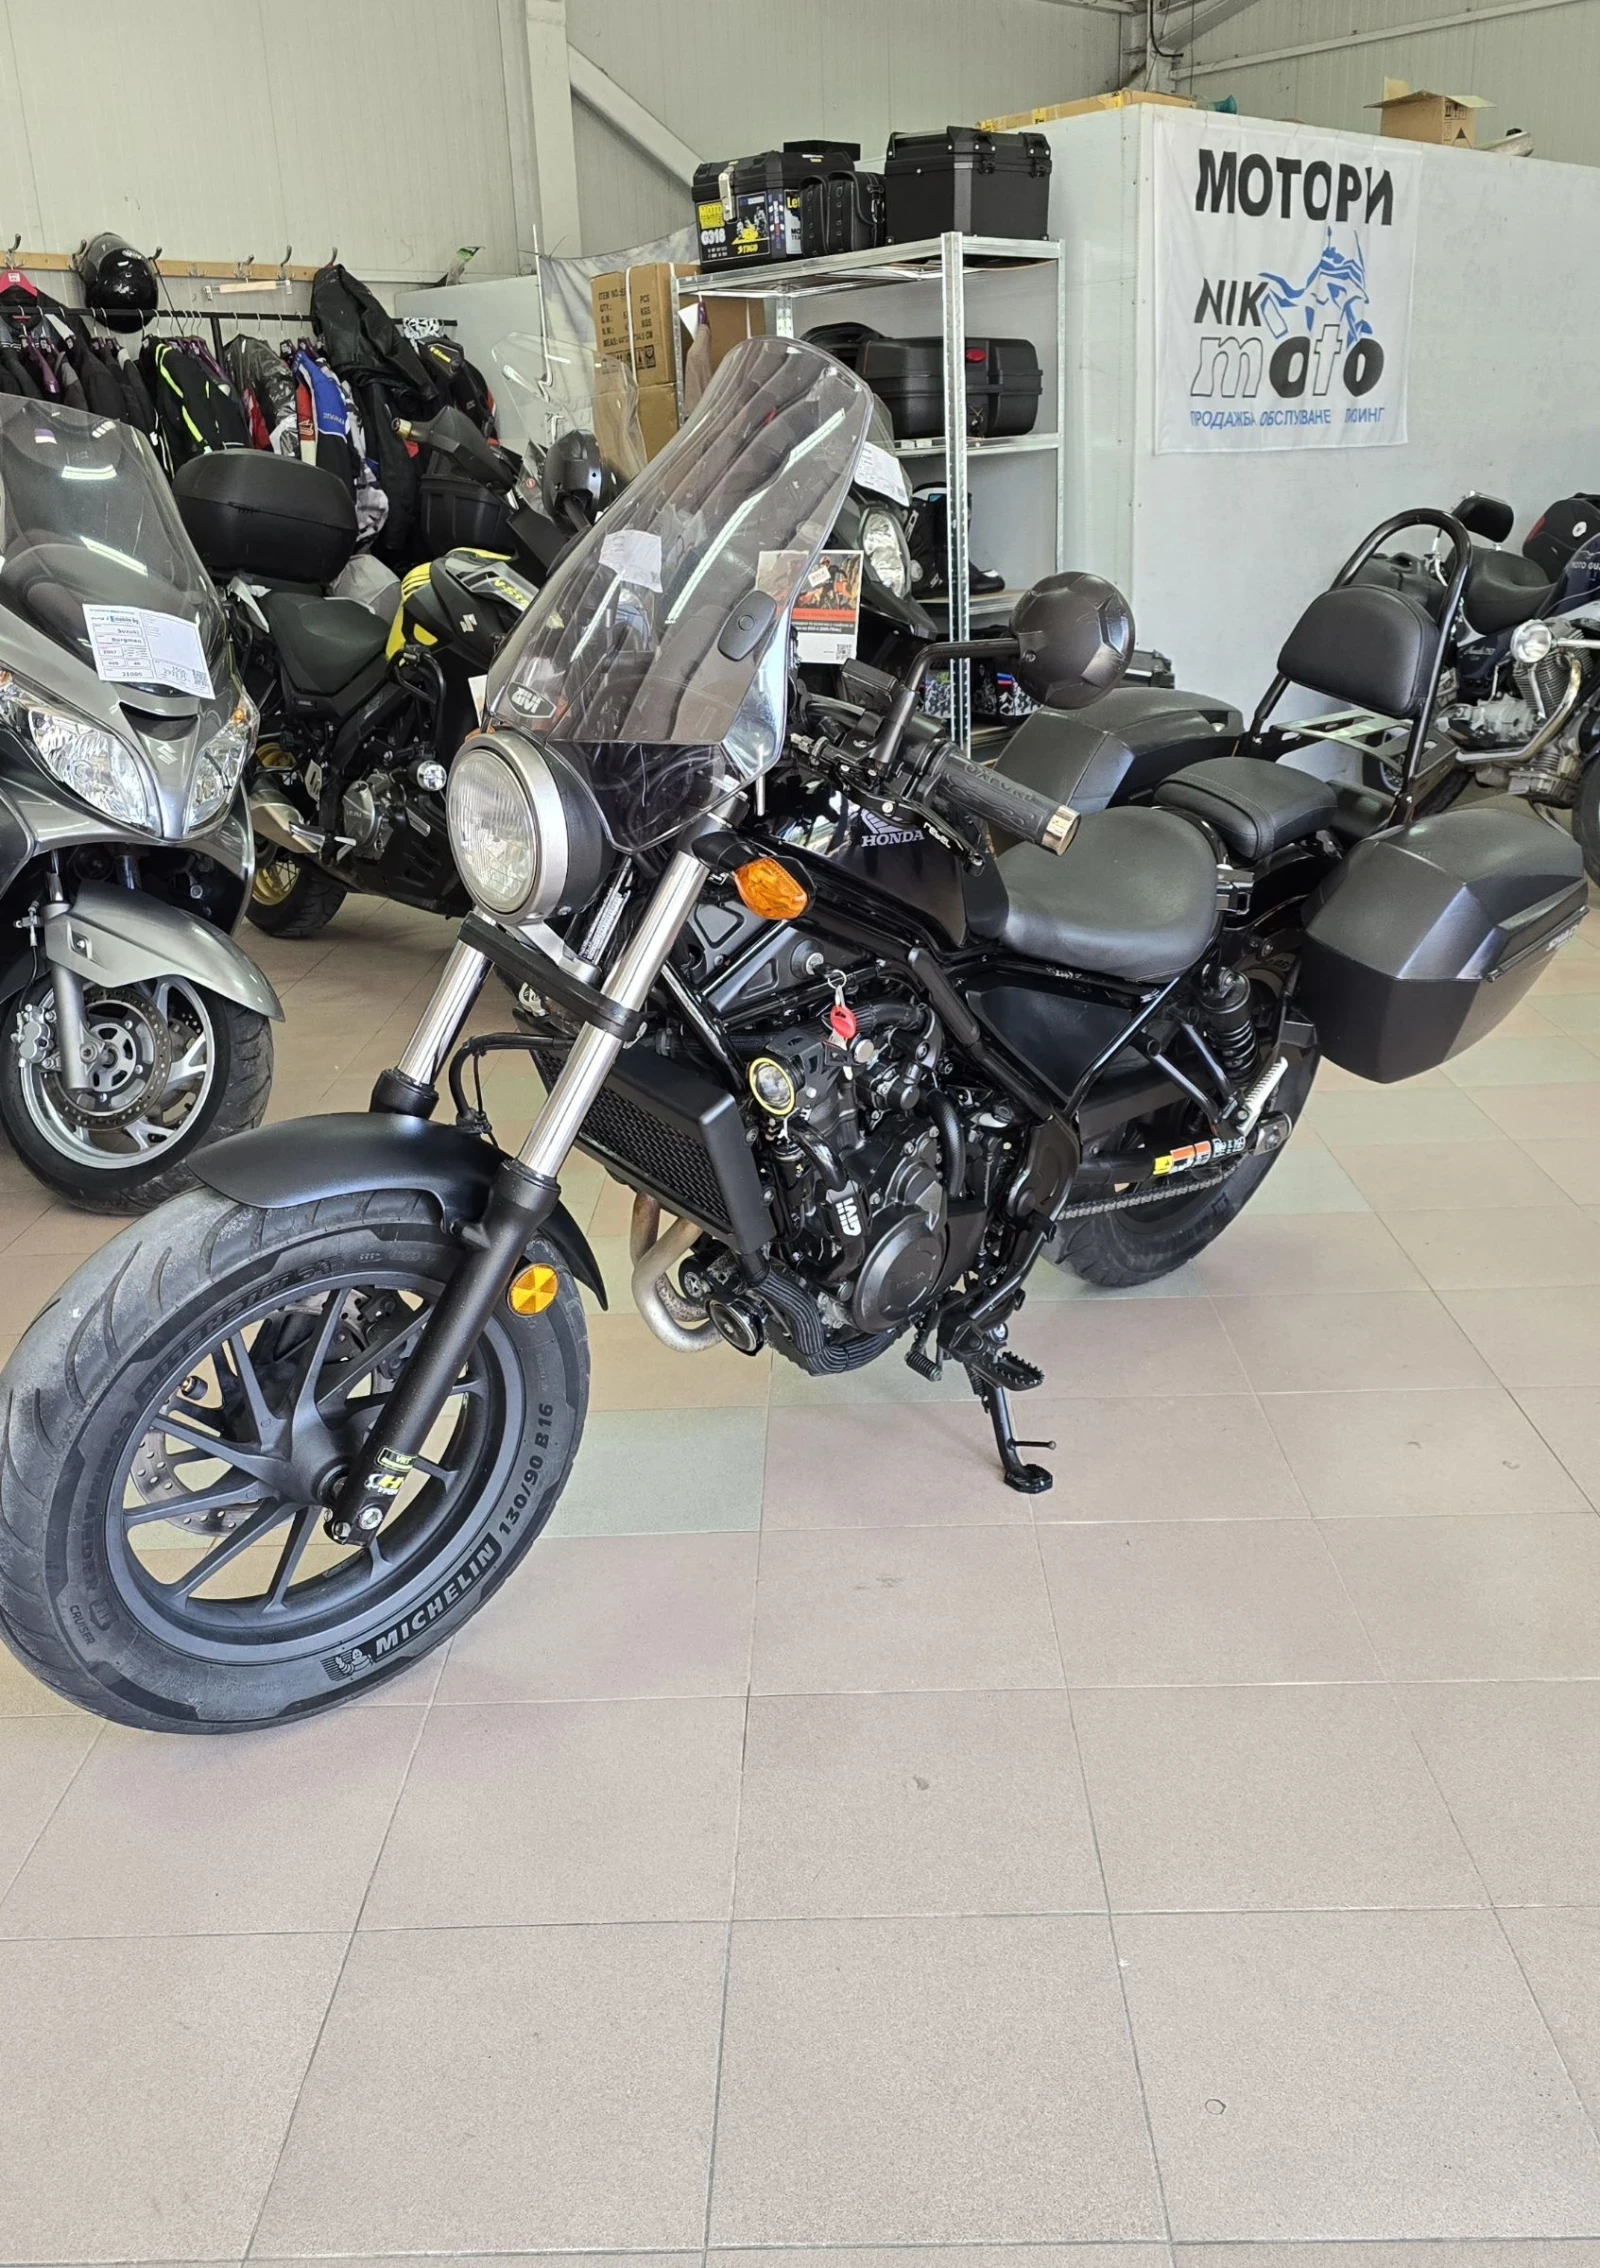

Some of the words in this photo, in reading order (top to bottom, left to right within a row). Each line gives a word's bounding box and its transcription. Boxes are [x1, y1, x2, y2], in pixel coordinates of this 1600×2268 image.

[1196, 148, 1394, 226] МОТОРИ
[701, 228, 726, 245] G318
[1194, 277, 1269, 326] NIK
[1190, 324, 1385, 398] moto
[861, 829, 926, 847] HONDA
[836, 1197, 862, 1236] GIVI
[538, 1403, 555, 1429] 16
[534, 1432, 550, 1450] B
[499, 1457, 544, 1536] 130/90
[374, 1541, 496, 1657] MICHELIN
[69, 1604, 96, 1647] CRUISER
